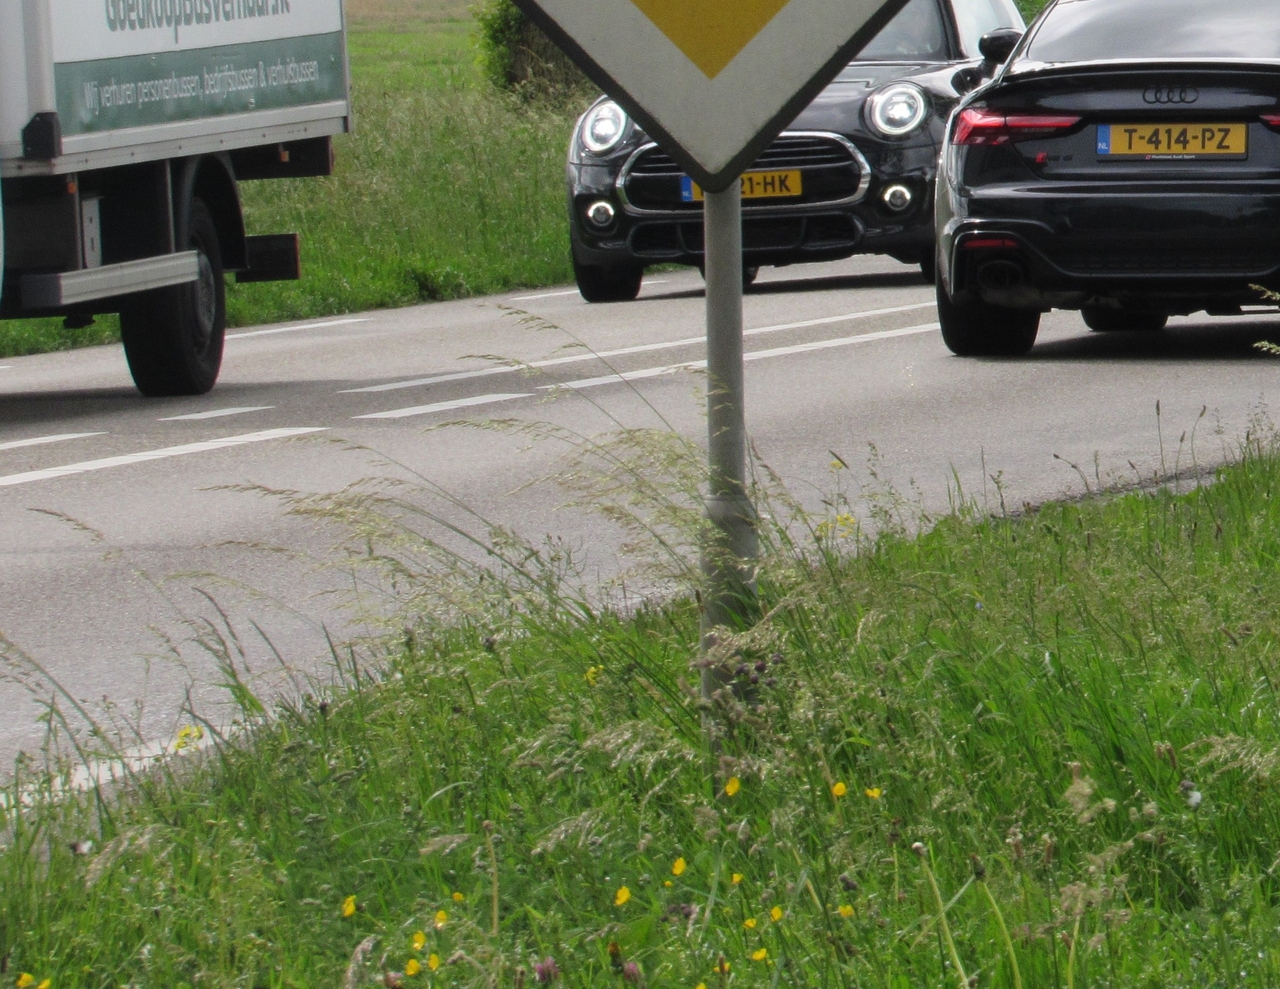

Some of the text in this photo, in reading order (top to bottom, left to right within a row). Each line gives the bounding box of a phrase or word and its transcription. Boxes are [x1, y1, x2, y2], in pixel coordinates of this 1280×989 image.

[84, 81, 100, 115] Wij
[99, 77, 136, 108] verhuren
[203, 63, 258, 99] bedrijfsbussen
[258, 60, 267, 88] &
[266, 56, 320, 86] verhuisbussen
[1098, 127, 1231, 151] NL T-414-PZ
